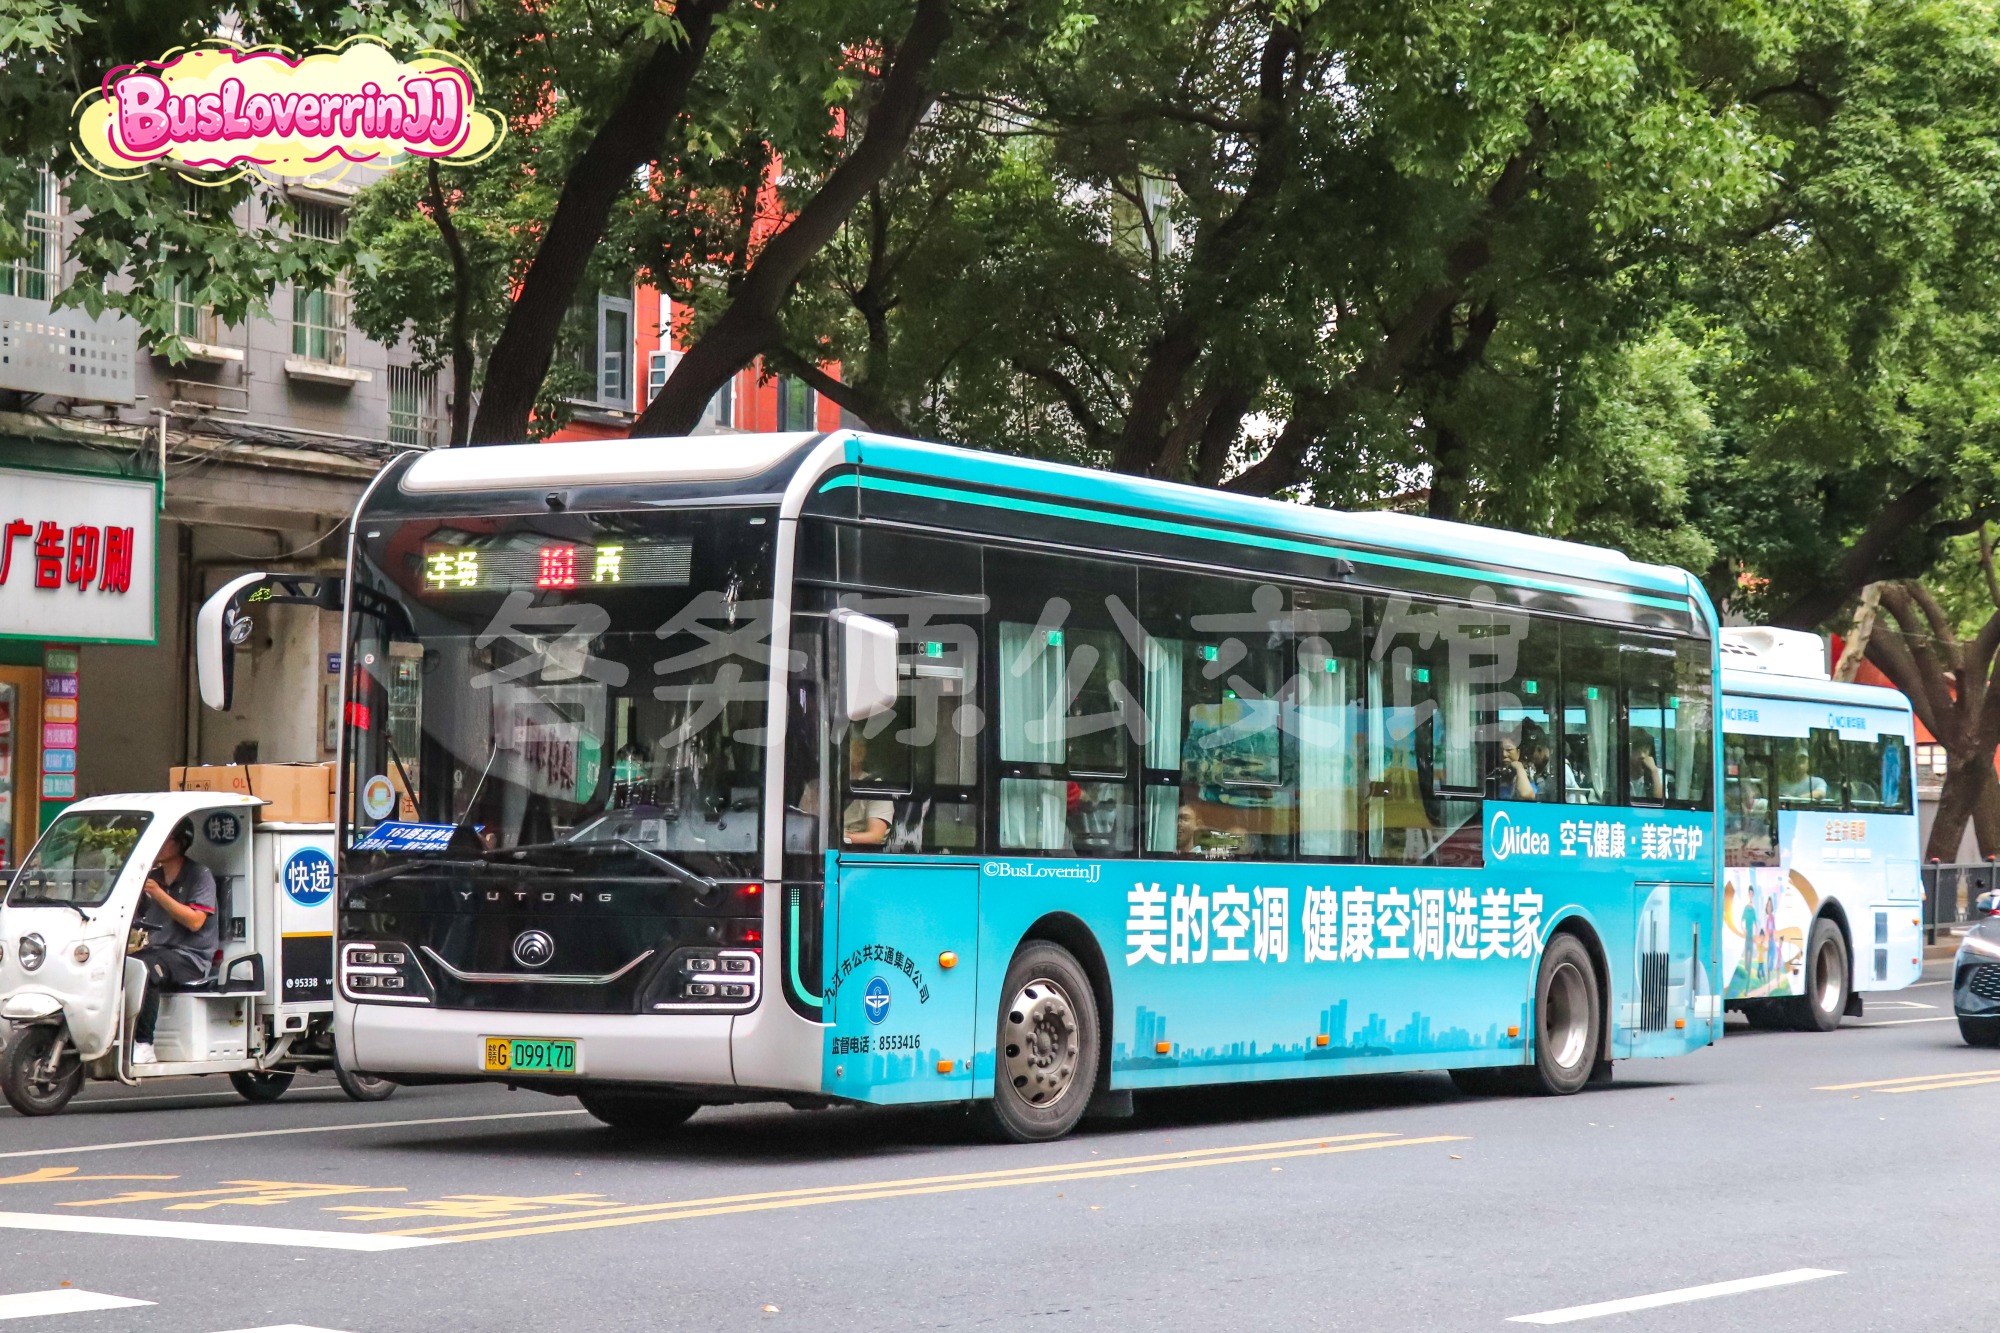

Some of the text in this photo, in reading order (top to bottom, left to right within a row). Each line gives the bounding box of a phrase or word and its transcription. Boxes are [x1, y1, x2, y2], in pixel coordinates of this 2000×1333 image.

[0, 518, 135, 593] 广告印刷
[539, 547, 576, 587] 161
[208, 818, 235, 841] 快递
[1492, 813, 1549, 859] Midea
[288, 859, 332, 894] 快递
[460, 891, 613, 902] YUTONG
[1126, 882, 1545, 967] 美的空调 健康空调选美家
[294, 978, 318, 988] 95338
[824, 943, 931, 1005] 九江市公共交通集团公司
